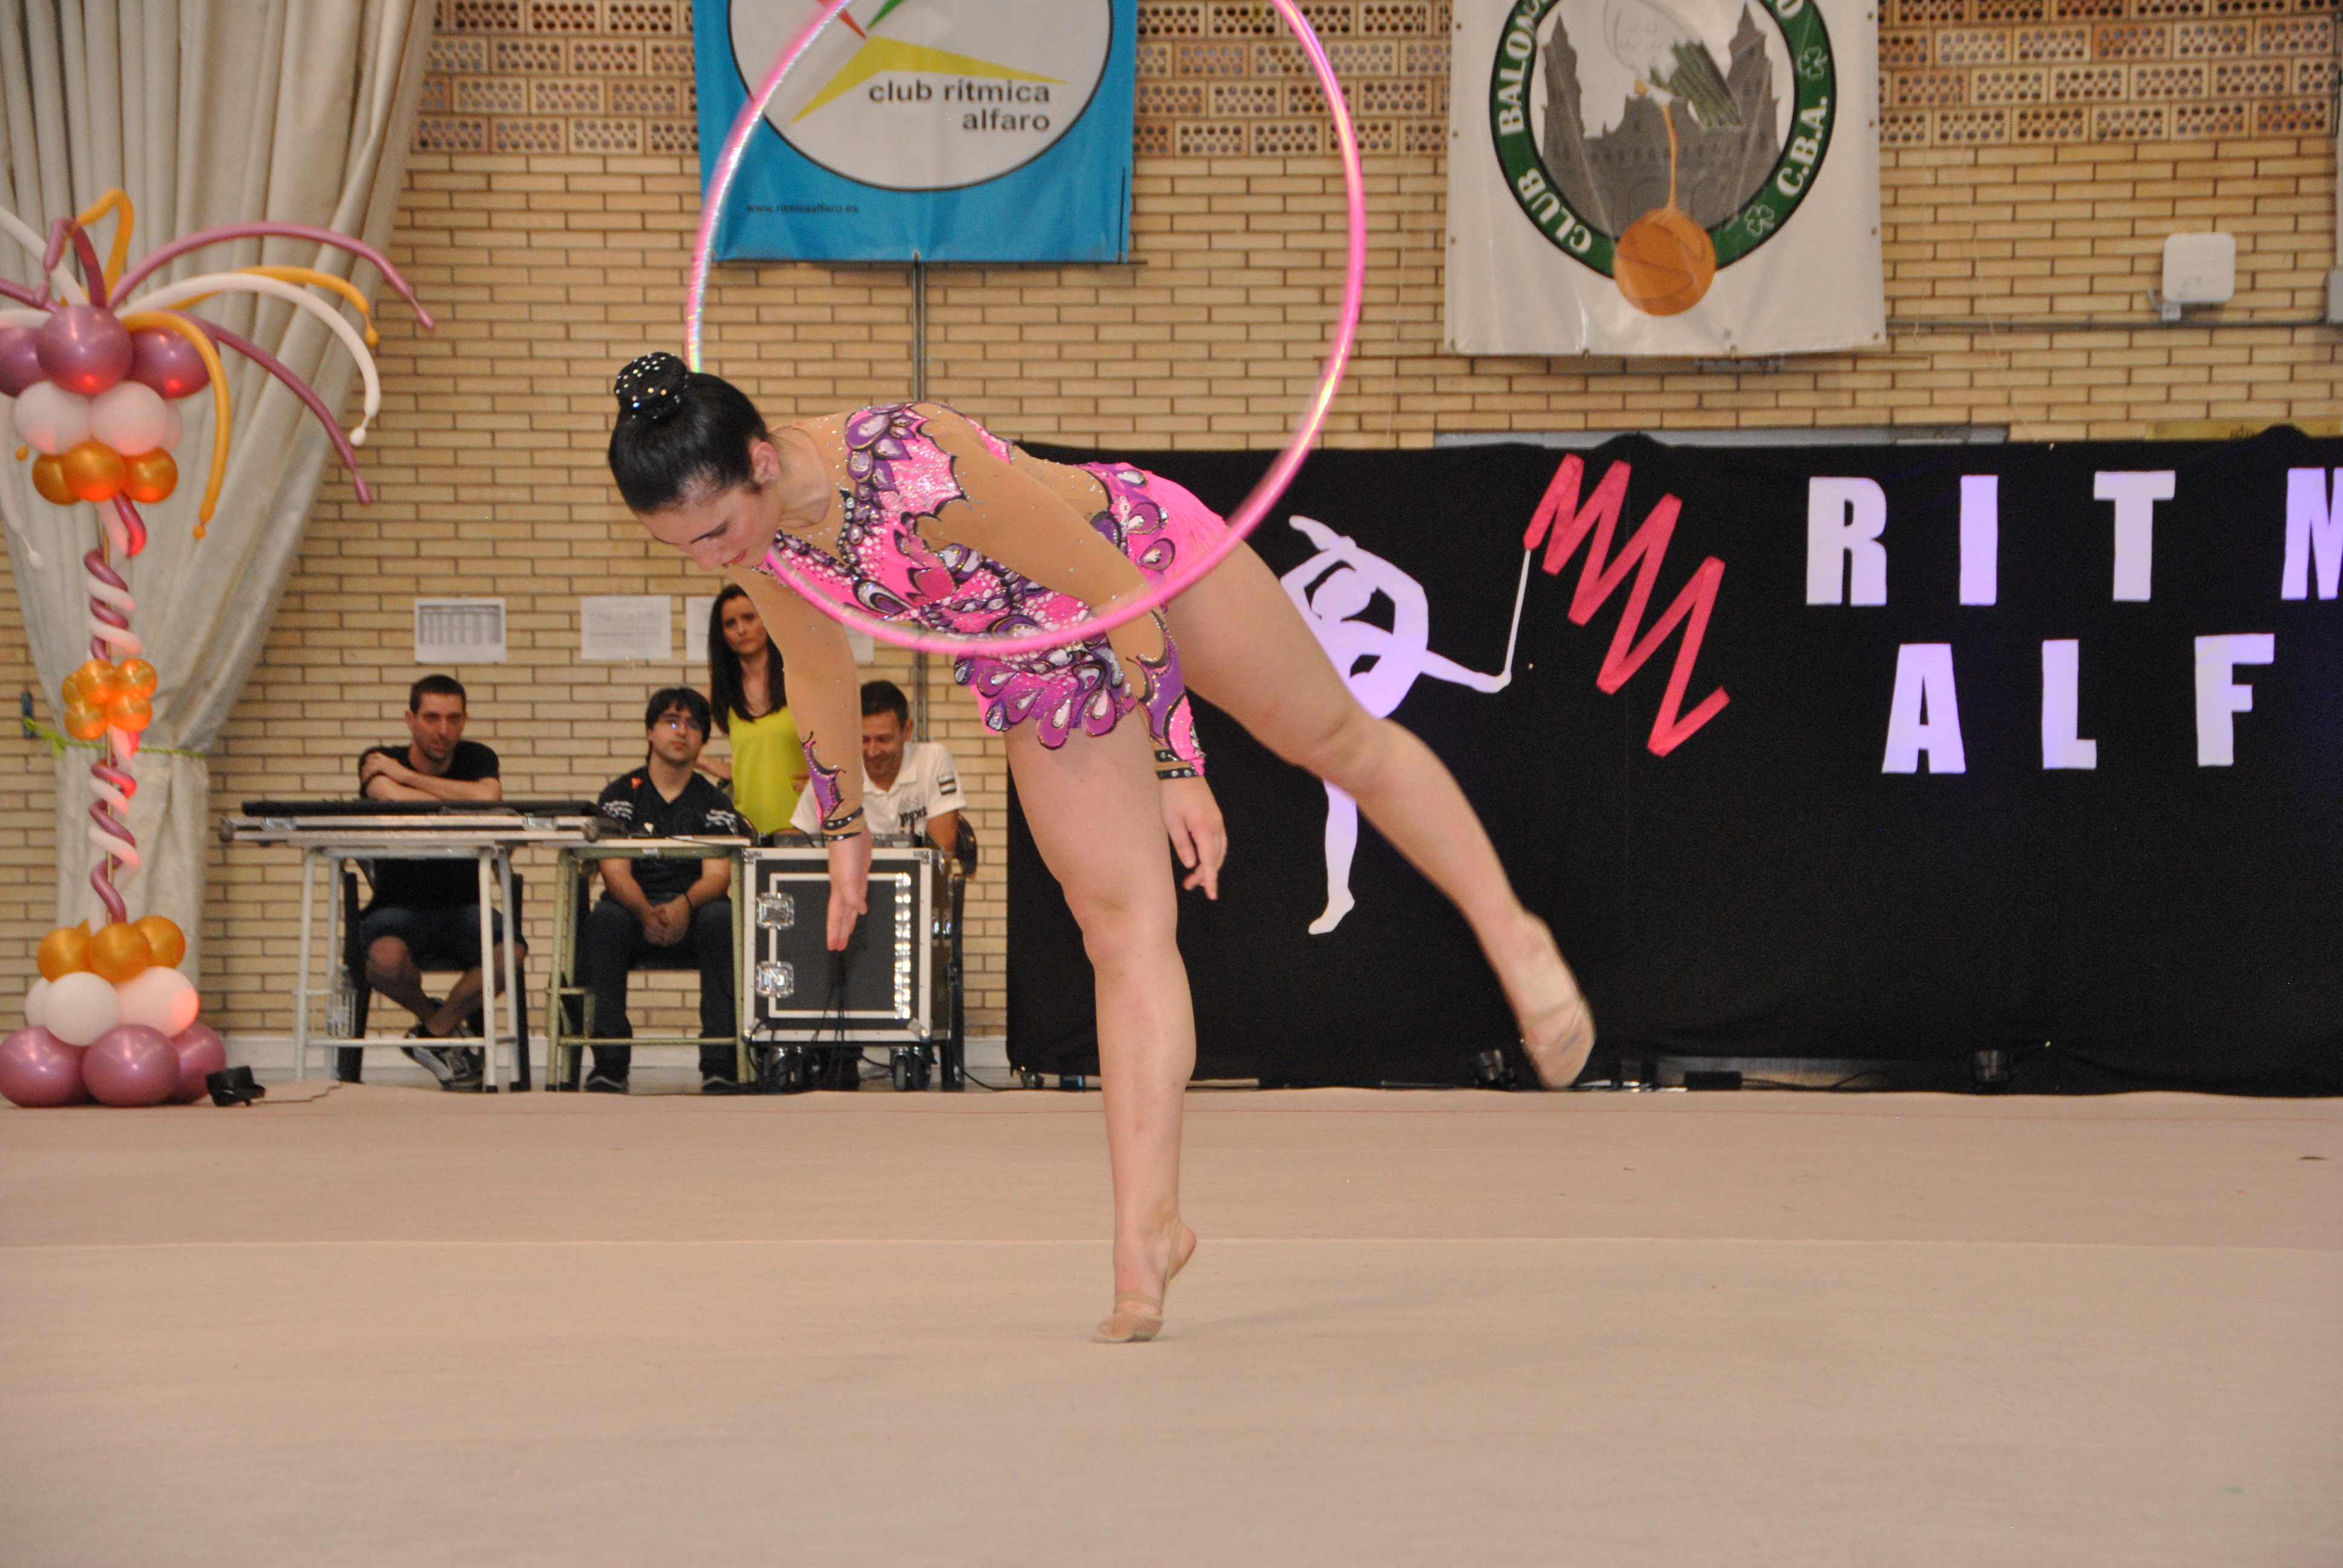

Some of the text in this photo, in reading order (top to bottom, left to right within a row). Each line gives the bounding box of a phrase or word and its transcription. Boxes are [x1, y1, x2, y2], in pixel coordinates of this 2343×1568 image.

[870, 79, 932, 102] club
[962, 108, 1050, 131] alfaro
[1777, 96, 1827, 197] C.B.A.
[1517, 168, 1593, 253] CLUB
[1881, 633, 2275, 774] ALF
